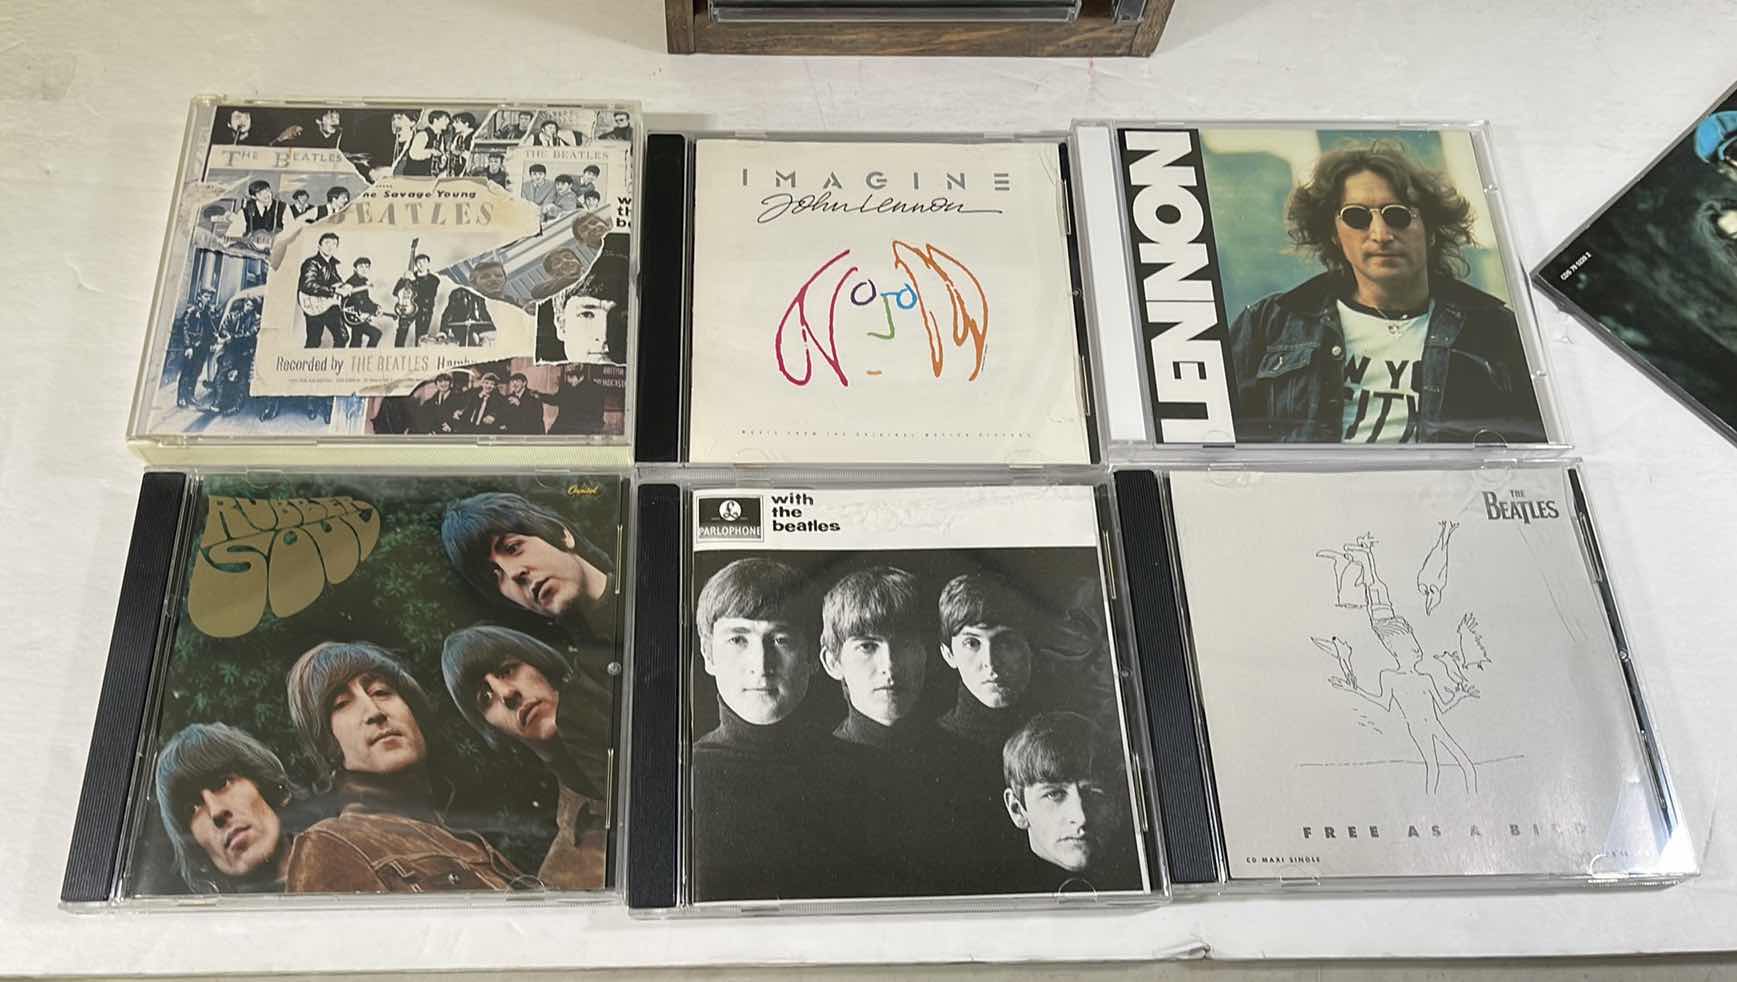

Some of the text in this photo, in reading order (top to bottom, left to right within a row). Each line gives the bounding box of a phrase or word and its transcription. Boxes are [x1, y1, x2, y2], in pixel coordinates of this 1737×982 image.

[742, 168, 1011, 192] IMAGINE
[383, 190, 432, 199] Savage
[436, 190, 477, 199] Young
[1124, 130, 1236, 443] LENNON
[276, 356, 327, 372] Recorded
[332, 356, 344, 376] by
[350, 356, 374, 372] THE
[377, 356, 429, 372] BEATLES
[771, 493, 814, 505] with
[1510, 489, 1525, 498] THE
[772, 506, 802, 518] the
[1481, 491, 1559, 524] BEATLES
[699, 526, 761, 536] PARLOPHONE
[773, 520, 841, 532] beatles
[1302, 826, 1380, 840] FREE
[1407, 824, 1442, 839] AS
[1469, 824, 1482, 838] A
